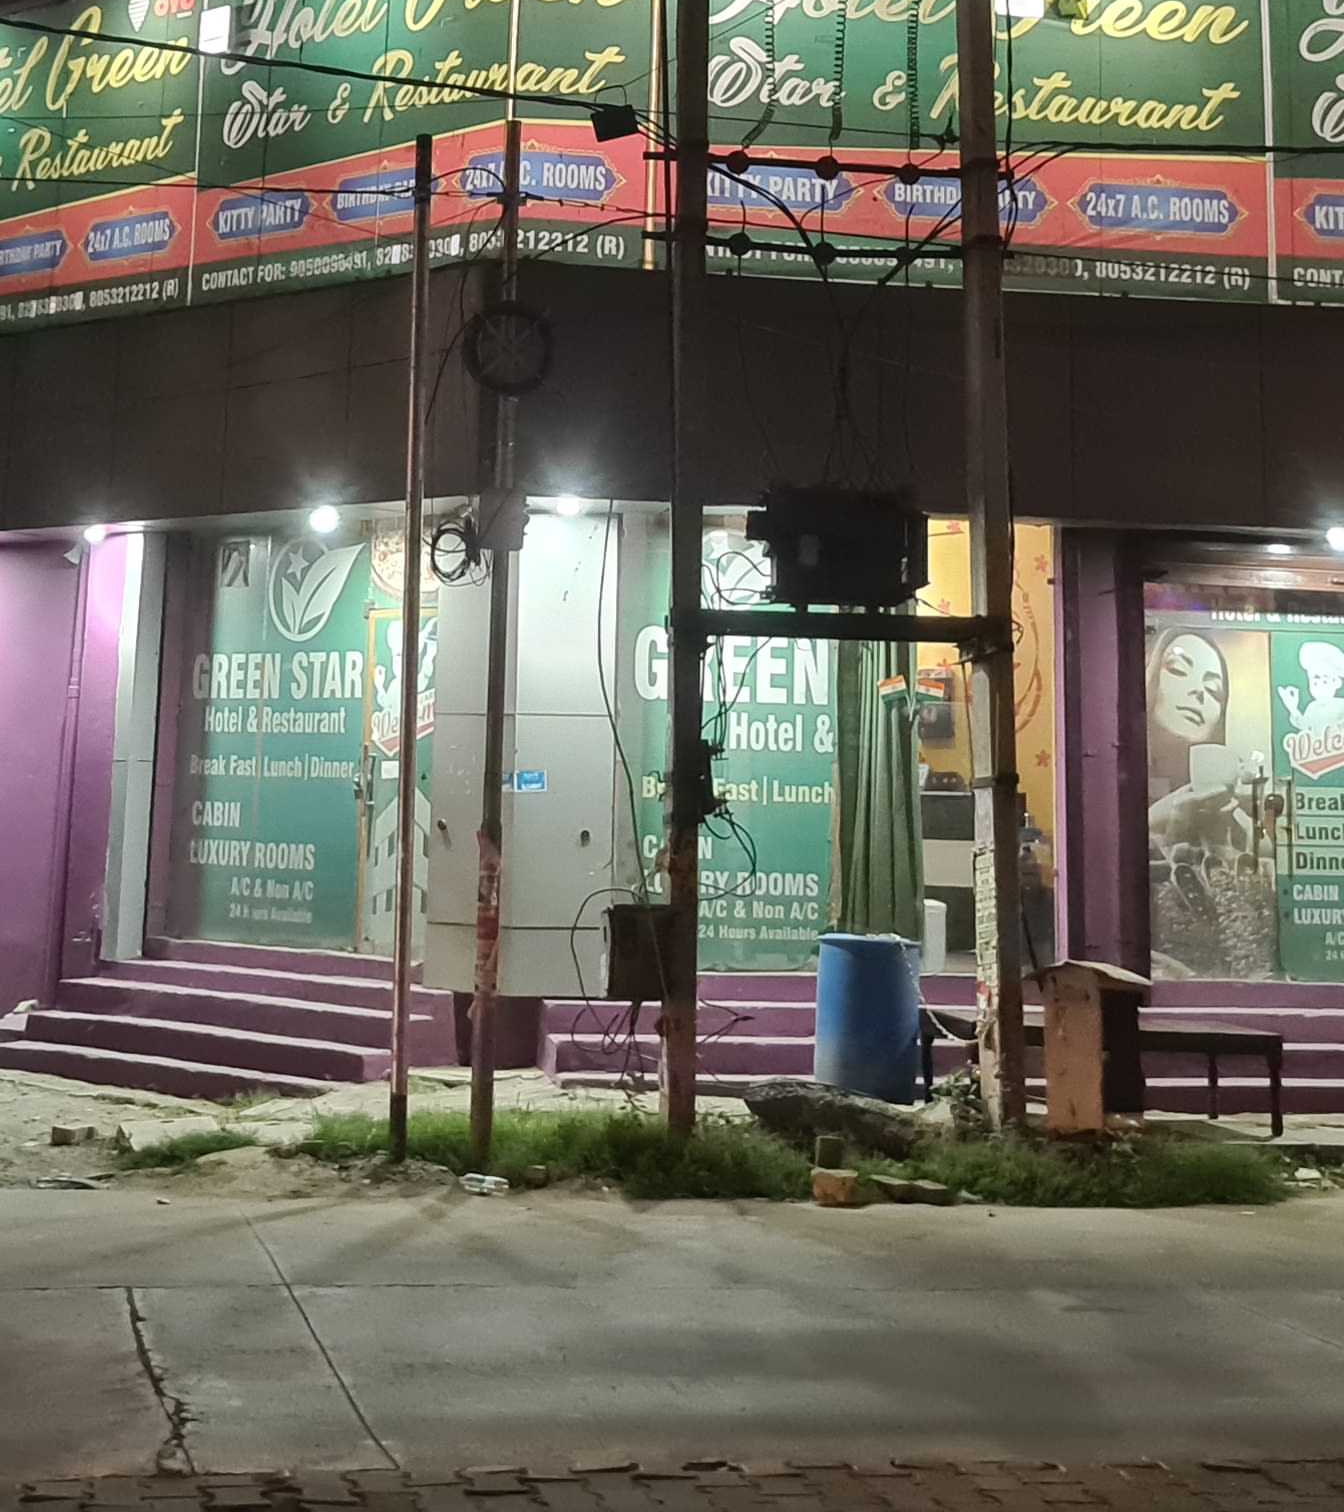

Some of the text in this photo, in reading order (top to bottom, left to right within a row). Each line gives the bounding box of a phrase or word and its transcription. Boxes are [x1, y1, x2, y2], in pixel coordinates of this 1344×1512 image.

[46, 5, 192, 111] Green
[707, 37, 846, 107] Star
[873, 70, 907, 110] &
[223, 46, 626, 148] Star & Restaurant
[11, 108, 185, 192] Restaurant
[466, 162, 606, 191] 24x7 ROOMS
[768, 174, 838, 204] PARTY
[217, 198, 301, 235] KITTY PARTY
[1086, 192, 1230, 225] 24x7 A.C. ROOMS
[134, 219, 171, 247] ROOMS
[33, 239, 63, 262] PARTY
[202, 266, 254, 291] CONTACT
[257, 263, 286, 284] FOR:
[596, 234, 624, 259] (R)
[1096, 260, 1251, 290] 8053212212 (R)
[89, 281, 160, 309] 8053212212
[162, 278, 179, 301] (R)
[192, 650, 364, 700] GREEN STAR
[205, 706, 242, 733] Hotel
[247, 706, 258, 733] &
[262, 706, 346, 734] Restaurant
[729, 712, 834, 753] Hotel &
[190, 753, 354, 778] Break Fast Lunch Dinner
[713, 777, 833, 804] Fast Lunch
[192, 800, 241, 828] CABIN
[189, 839, 316, 870] LUXURY ROOMS
[736, 872, 819, 897] ROOMS
[1293, 884, 1339, 902] CABIN
[698, 900, 819, 920] A/C & Non A/C
[697, 924, 818, 940] 24 Hours Available
